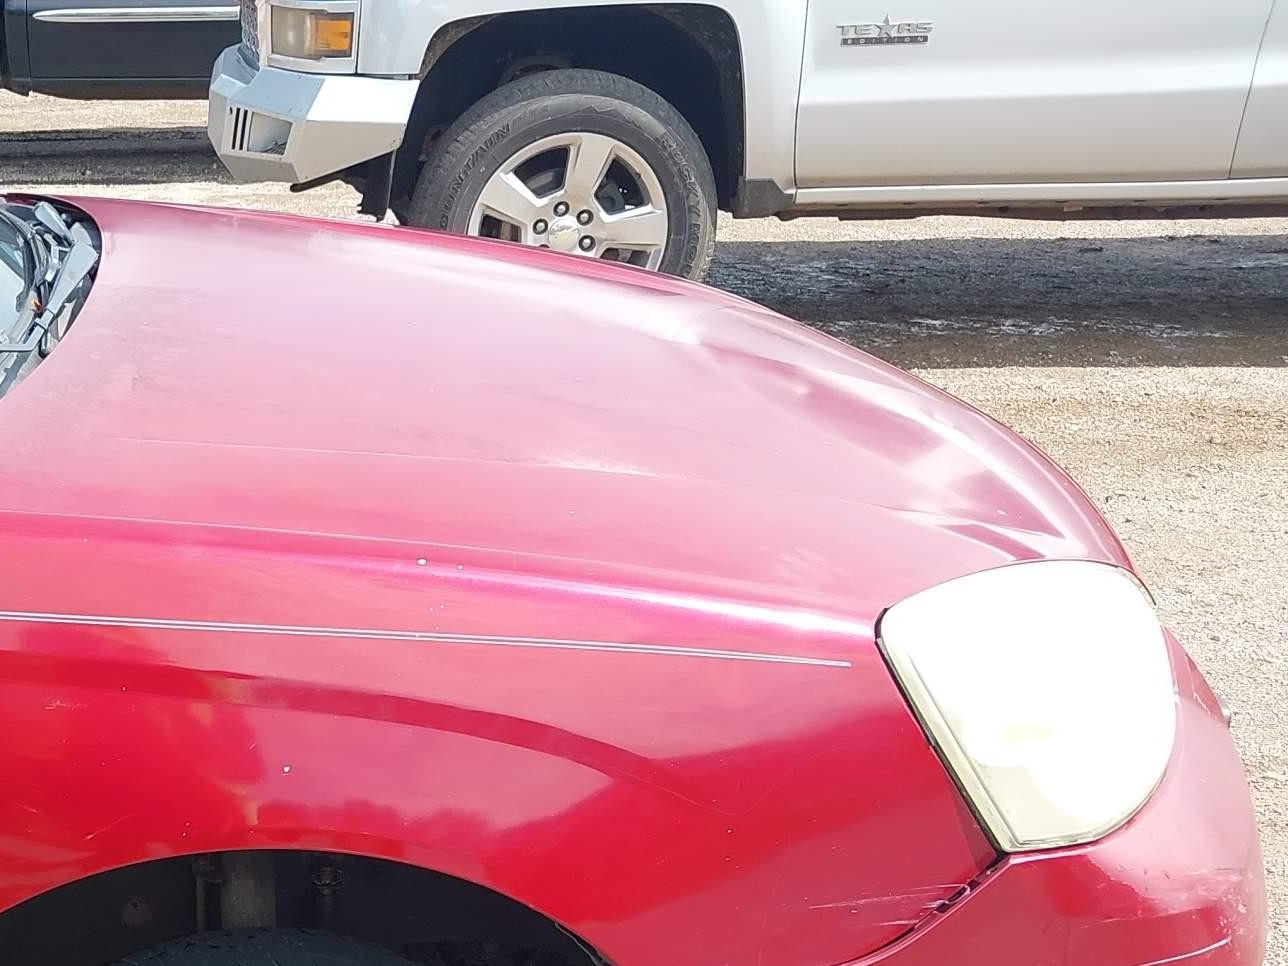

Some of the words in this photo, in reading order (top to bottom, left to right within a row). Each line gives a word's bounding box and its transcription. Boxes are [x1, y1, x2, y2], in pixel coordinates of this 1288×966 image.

[836, 16, 934, 37] TEXAS
[845, 36, 926, 45] EDITION
[439, 123, 511, 228] OUNTAIN
